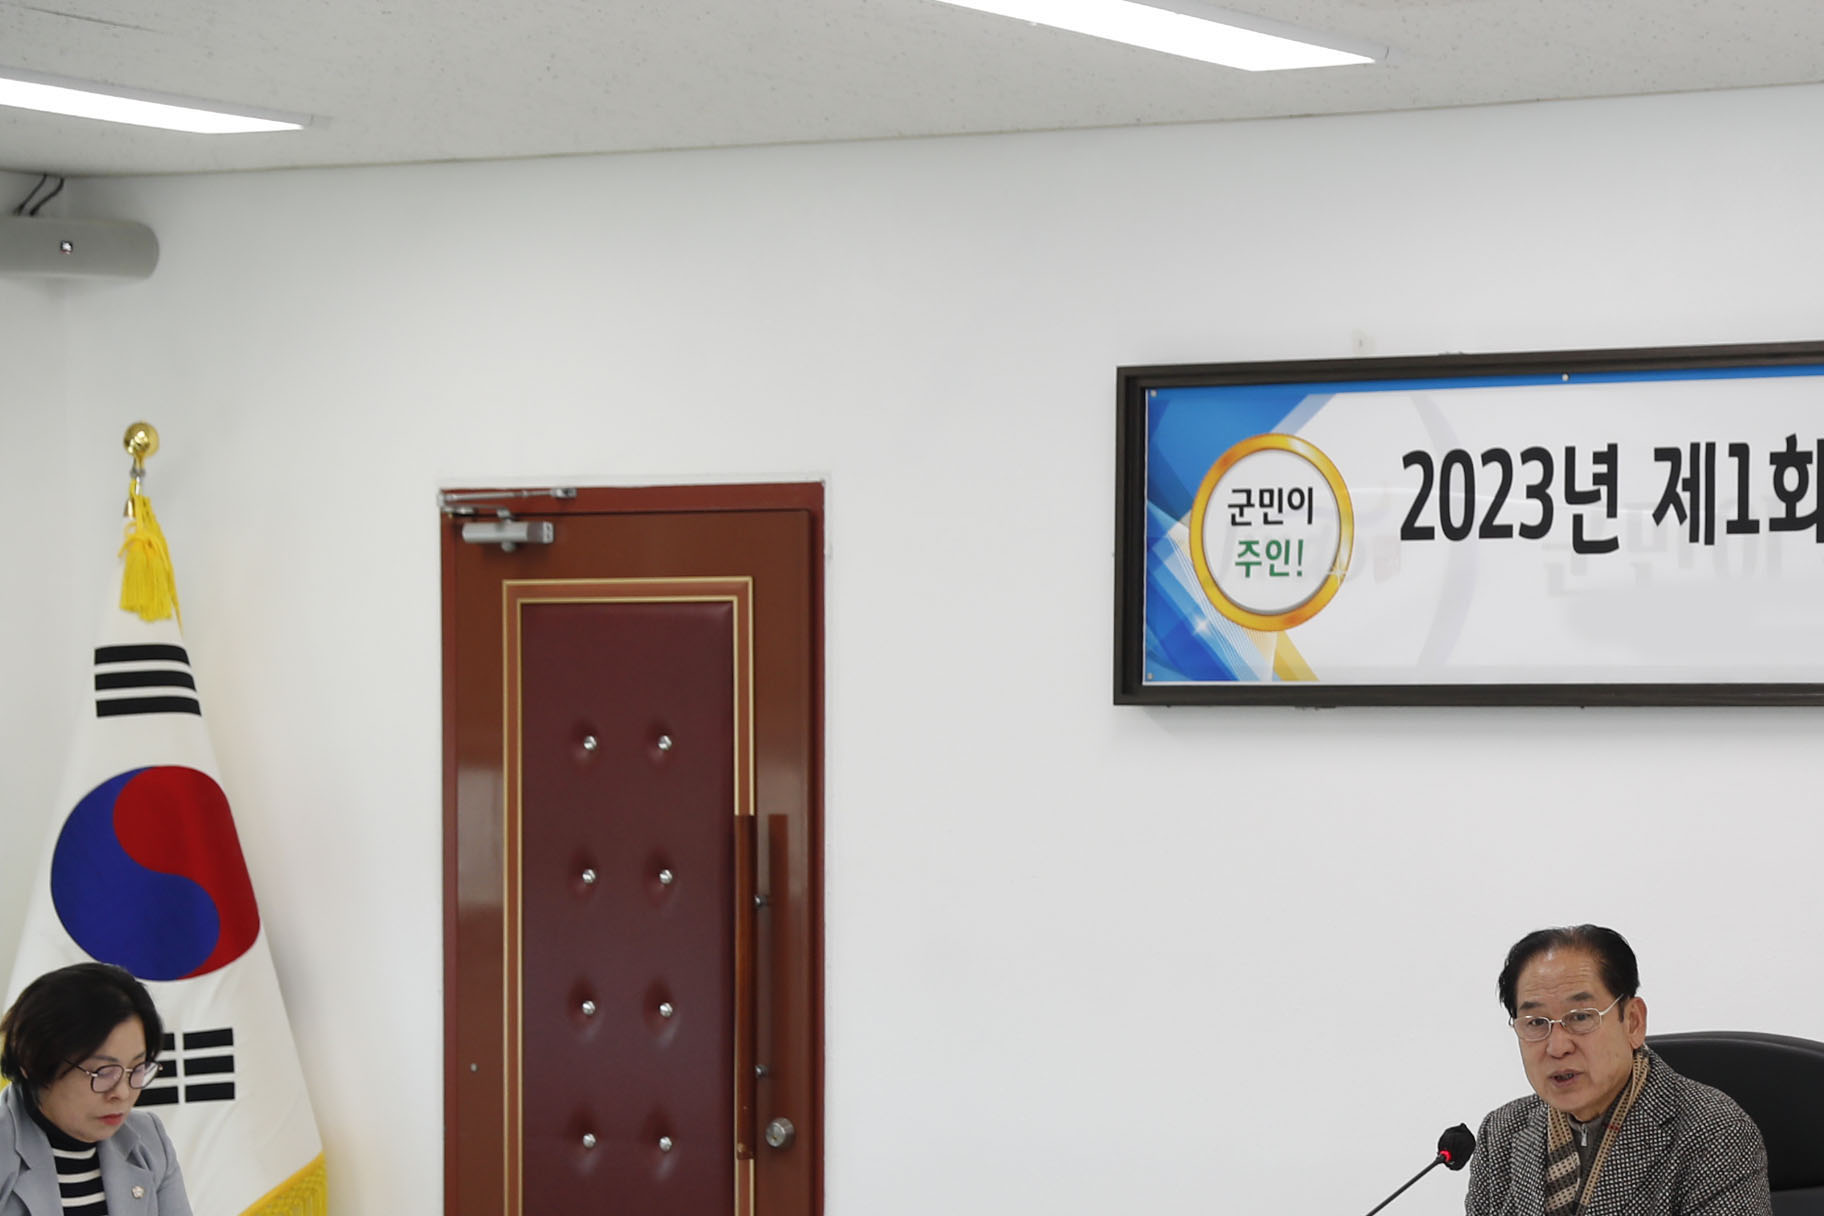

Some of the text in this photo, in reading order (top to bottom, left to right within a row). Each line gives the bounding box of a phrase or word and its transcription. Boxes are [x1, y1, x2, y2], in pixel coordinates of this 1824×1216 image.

[1226, 486, 1315, 528] 군민이
[1400, 443, 1620, 555] 2023년
[1234, 539, 1304, 579] 주인!
